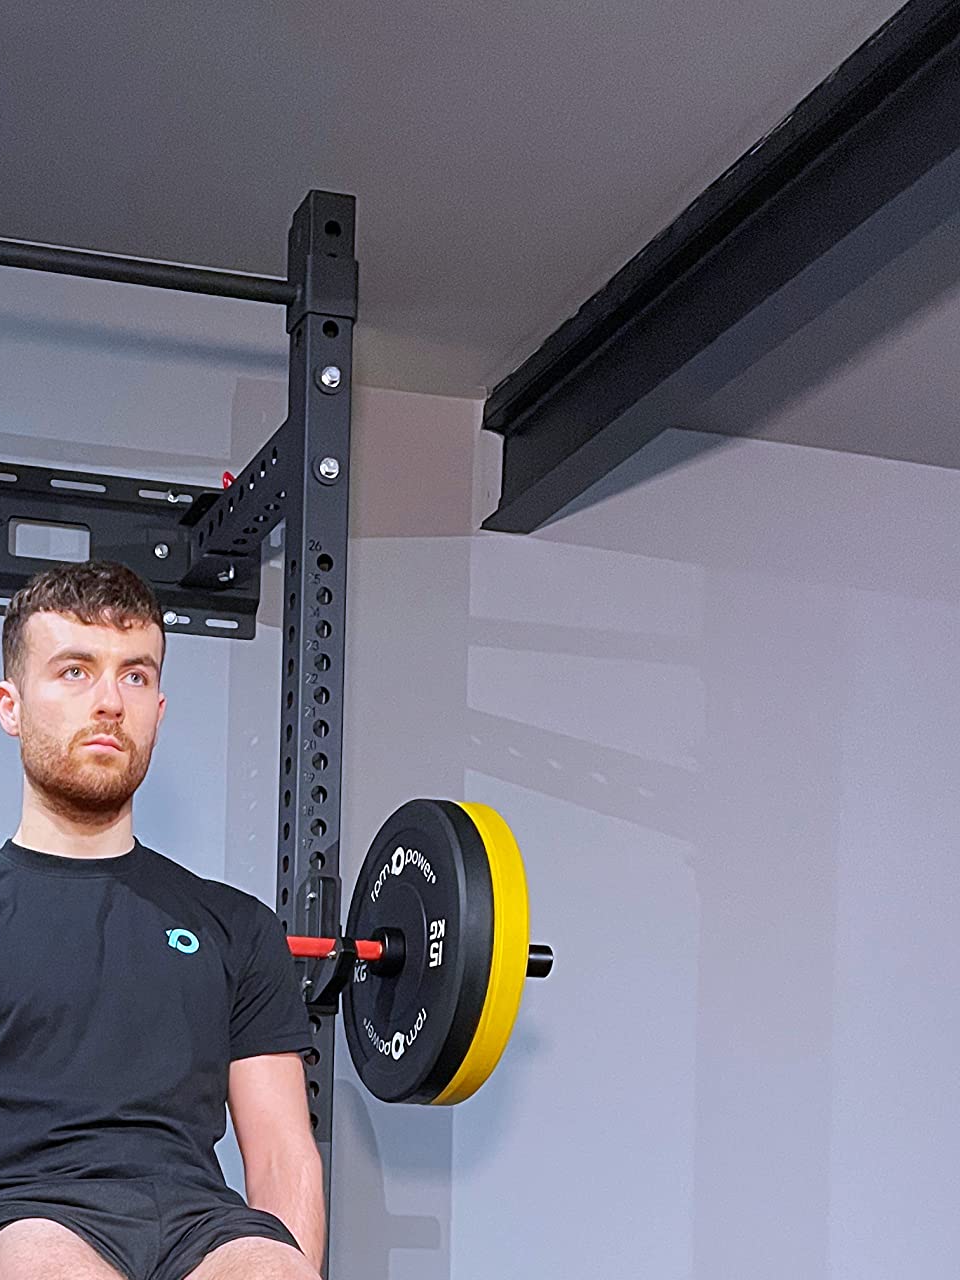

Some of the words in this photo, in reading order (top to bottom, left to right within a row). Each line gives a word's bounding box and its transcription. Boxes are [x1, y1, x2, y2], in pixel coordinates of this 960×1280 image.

[308, 539, 322, 551] 26
[306, 639, 320, 651] 23
[305, 672, 319, 685] 22
[304, 706, 316, 718] 21
[370, 863, 391, 902] rpm
[429, 918, 446, 940] KG
[429, 940, 444, 968] 15
[353, 964, 367, 983] KG
[405, 1007, 427, 1046] rpm
